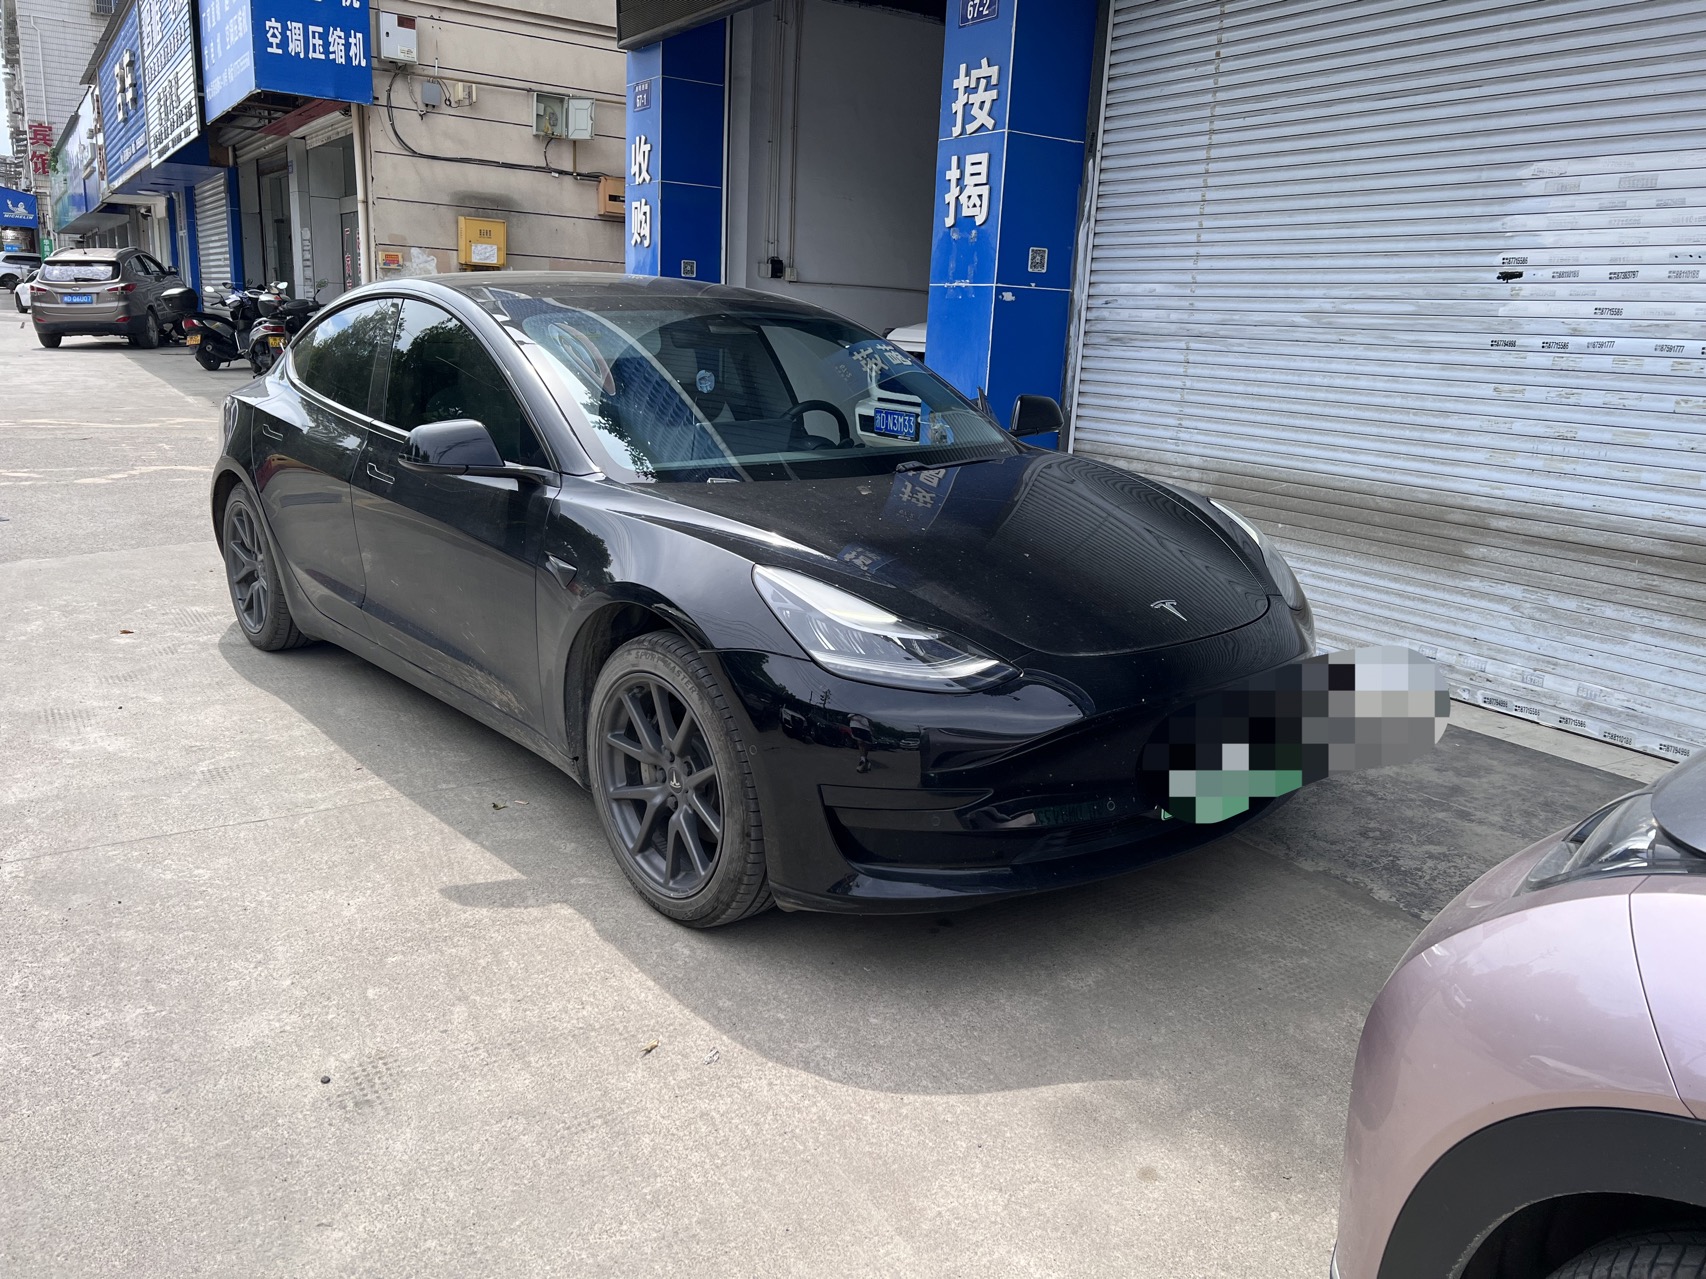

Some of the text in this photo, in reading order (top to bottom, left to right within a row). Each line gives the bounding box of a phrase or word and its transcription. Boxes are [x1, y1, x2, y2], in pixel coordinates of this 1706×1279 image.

[265, 18, 367, 67] 空调压缩机
[967, 0, 990, 19] 67-2
[945, 57, 999, 228] 按揭
[631, 135, 651, 247] 收购
